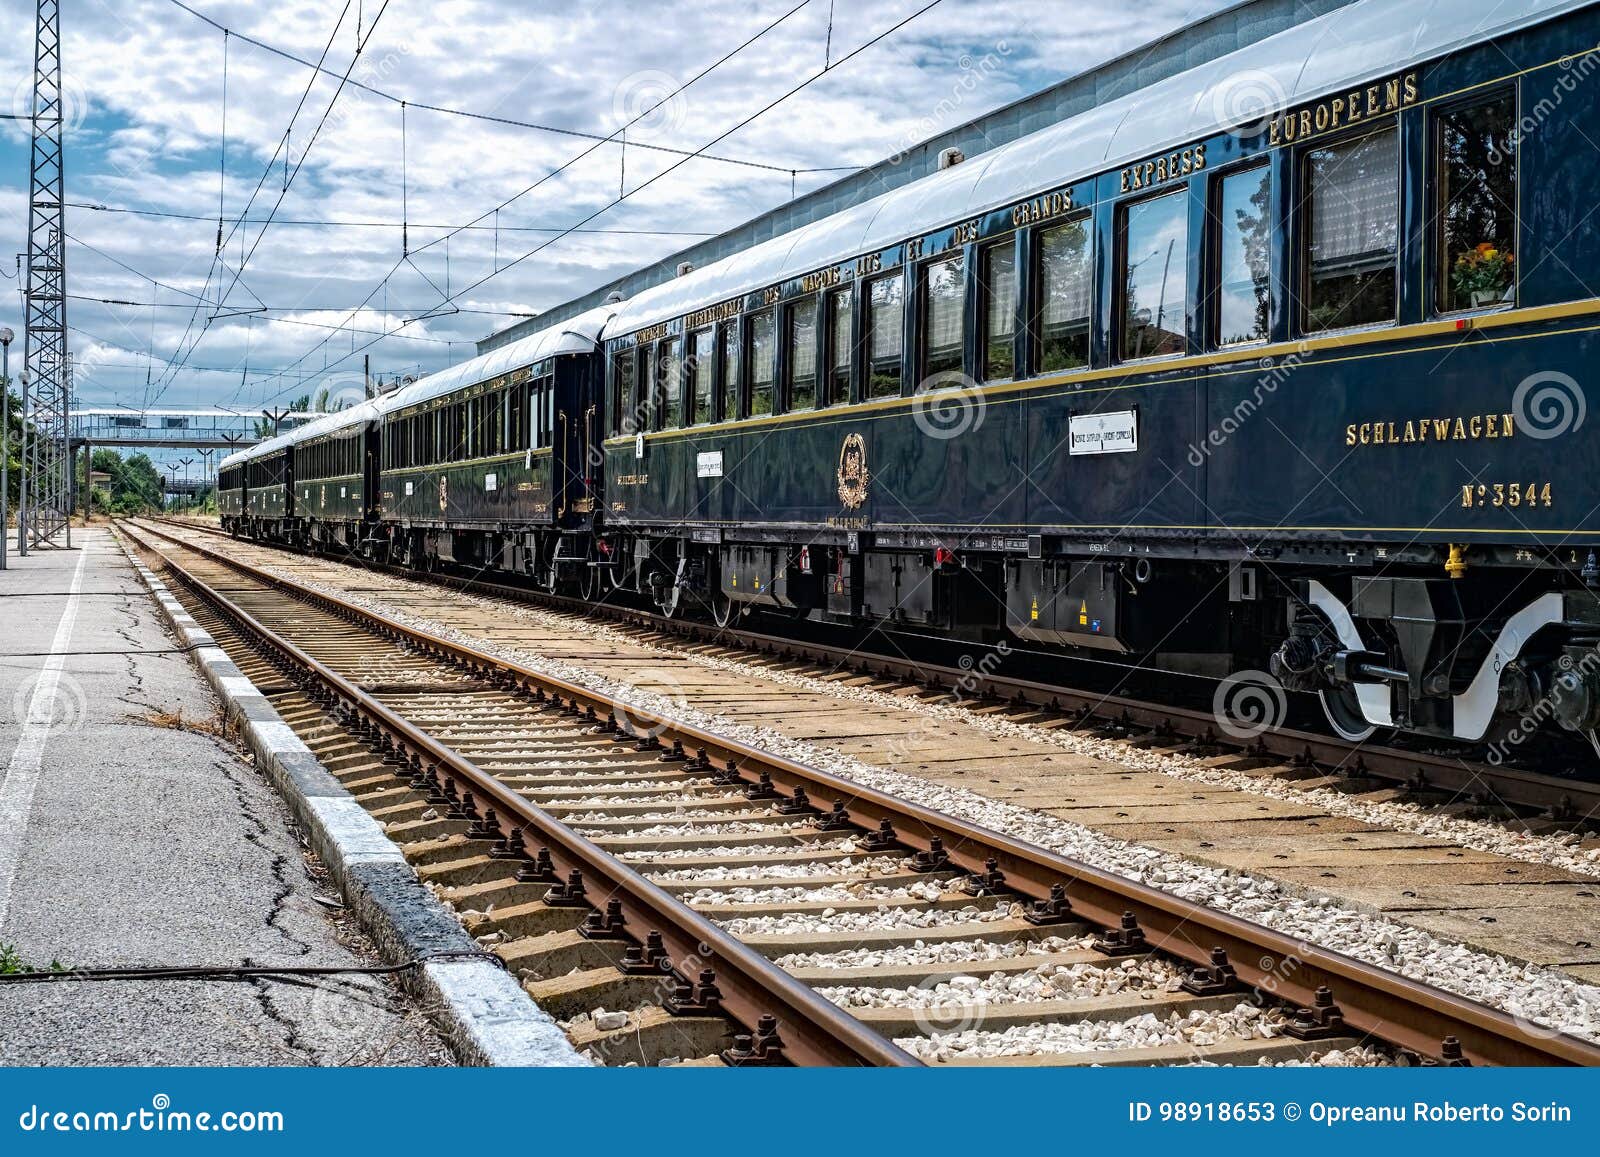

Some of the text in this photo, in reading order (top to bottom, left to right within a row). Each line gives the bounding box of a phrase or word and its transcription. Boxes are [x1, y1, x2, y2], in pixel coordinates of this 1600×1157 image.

[764, 287, 779, 305] DES
[856, 253, 882, 277] LITS
[908, 241, 925, 261] ET
[952, 219, 980, 247] DES
[1012, 189, 1074, 227] GRANDS
[1120, 144, 1208, 193] EXPRESS
[1269, 73, 1418, 146] EUROPEENS
[1346, 413, 1515, 446] SCHLAFWAGEN
[1570, 550, 1577, 563] 2
